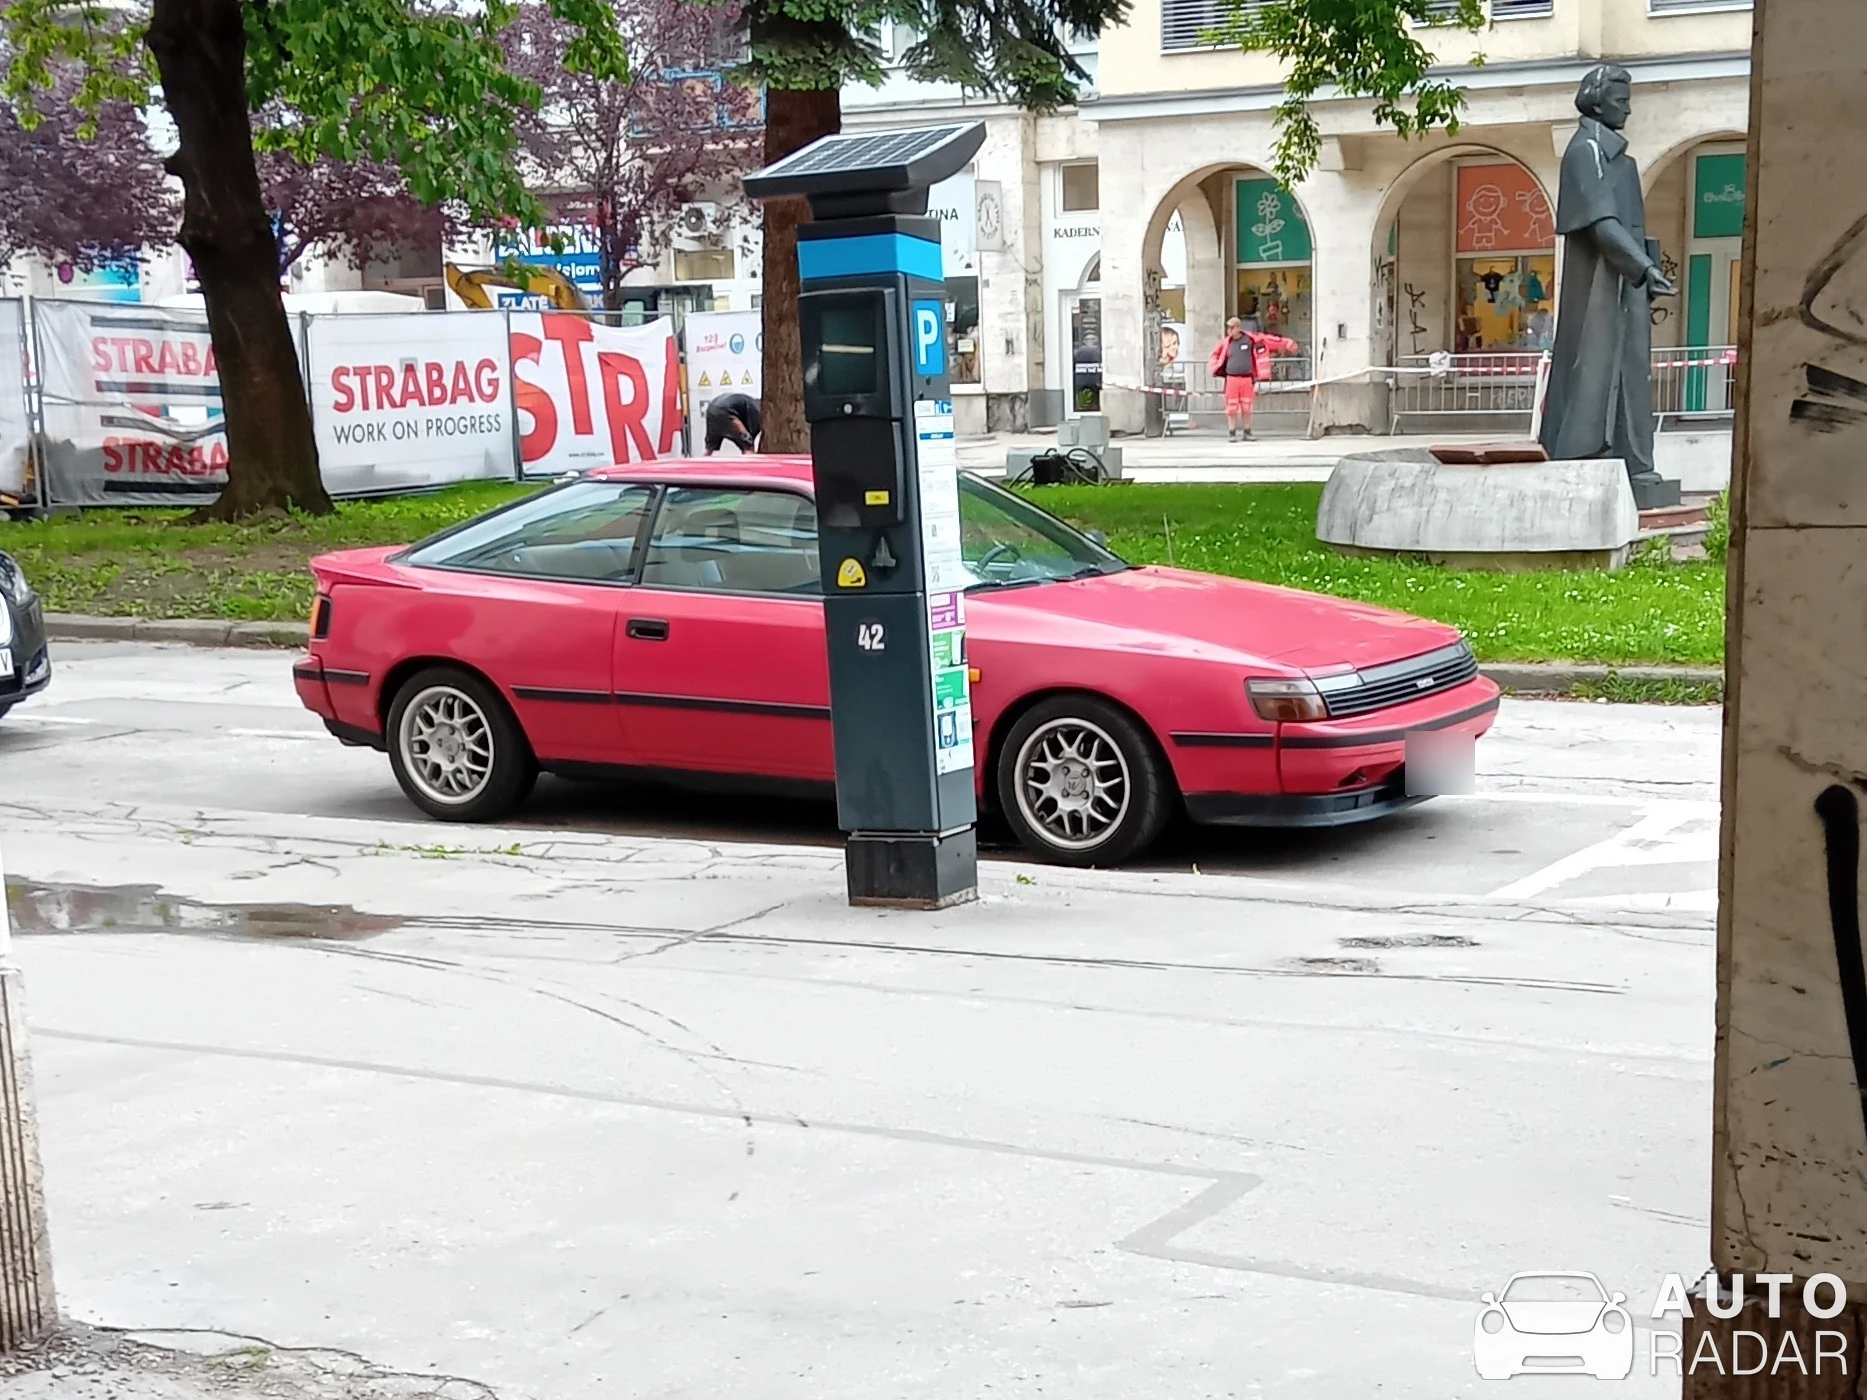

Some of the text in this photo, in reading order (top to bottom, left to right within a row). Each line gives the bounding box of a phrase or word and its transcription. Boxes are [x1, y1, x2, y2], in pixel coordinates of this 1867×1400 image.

[916, 308, 939, 365] P
[331, 358, 499, 412] STRABAG
[333, 413, 502, 444] WORK ON PROGRESS
[857, 623, 885, 650] 42
